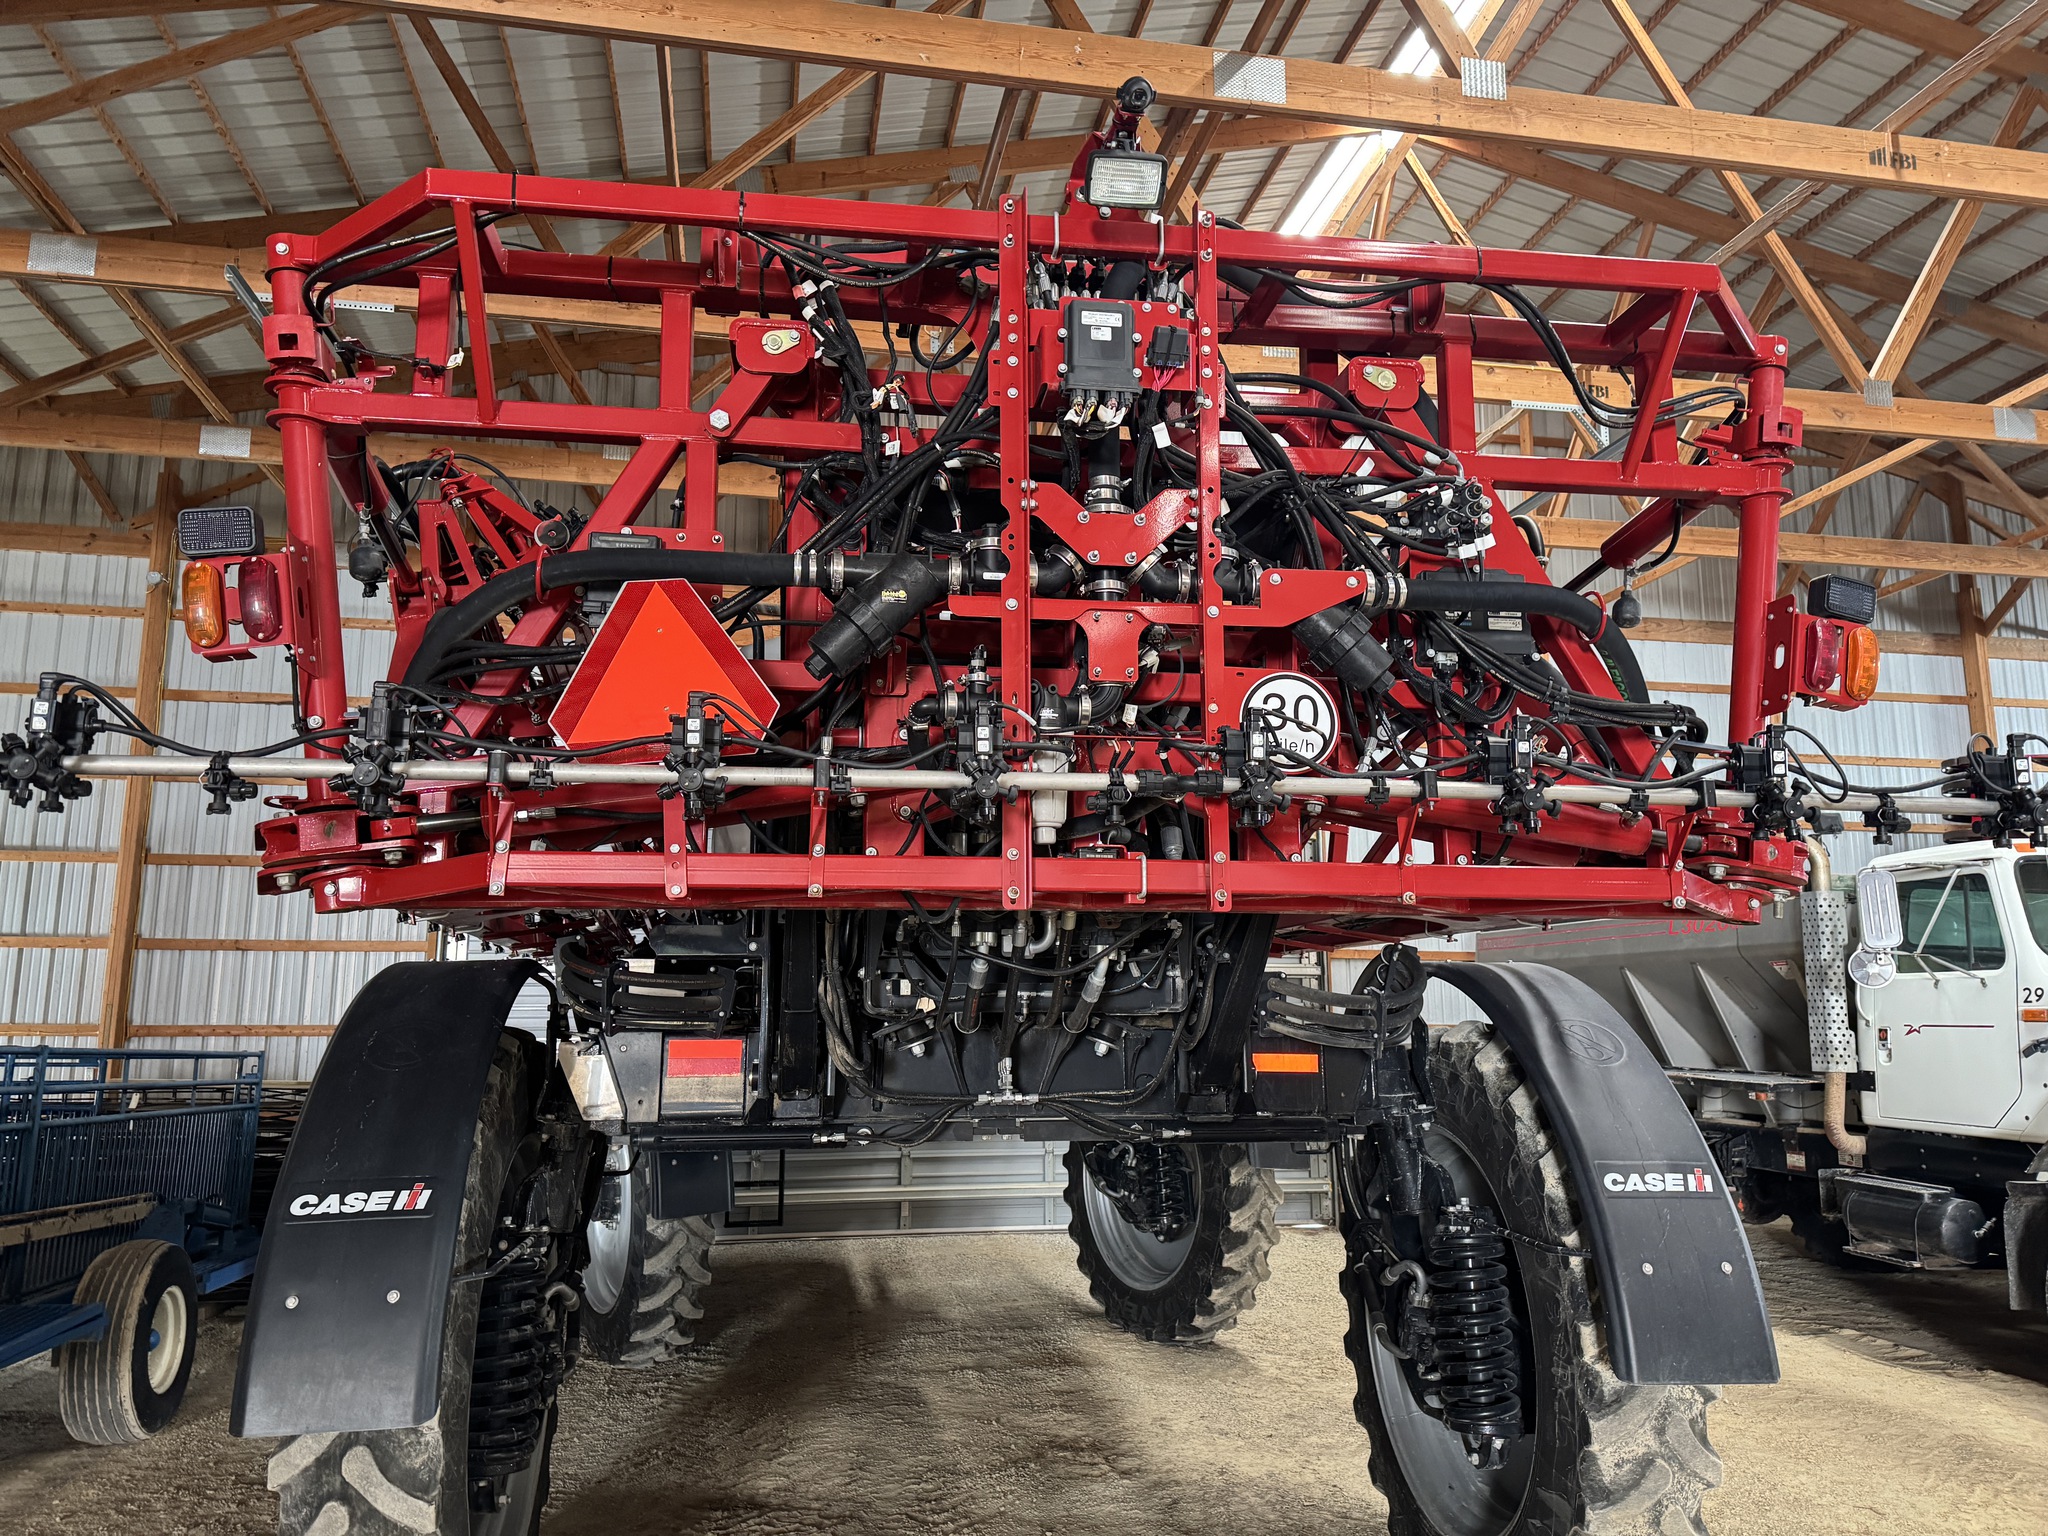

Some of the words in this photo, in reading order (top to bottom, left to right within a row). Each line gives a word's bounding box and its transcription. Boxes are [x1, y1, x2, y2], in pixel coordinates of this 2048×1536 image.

[1263, 692, 1319, 732] 30
[1269, 738, 1315, 753] ile/h
[2022, 987, 2045, 1003] 29
[1603, 1173, 1685, 1192] CASE
[289, 1190, 396, 1216] CASE
